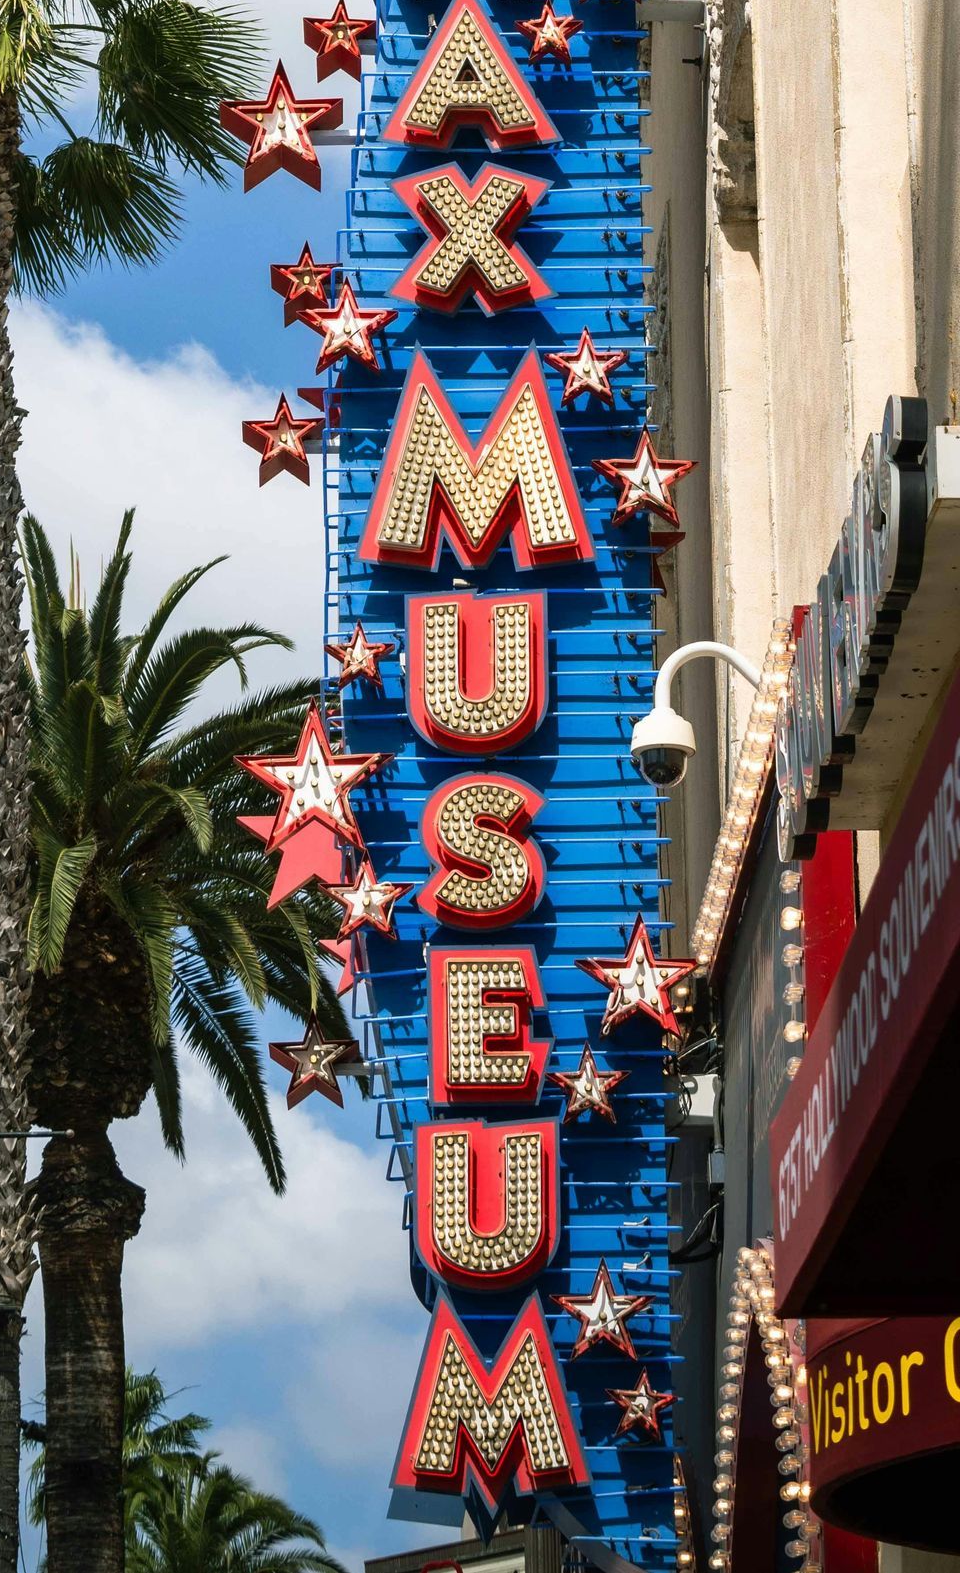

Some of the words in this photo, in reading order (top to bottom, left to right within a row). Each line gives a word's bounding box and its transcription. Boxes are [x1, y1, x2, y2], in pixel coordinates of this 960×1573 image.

[357, 339, 595, 1518] MUSEUM
[779, 1122, 803, 1242] 6757
[803, 950, 877, 1192] HOLLYWOOD
[809, 1351, 924, 1454] Visitor
